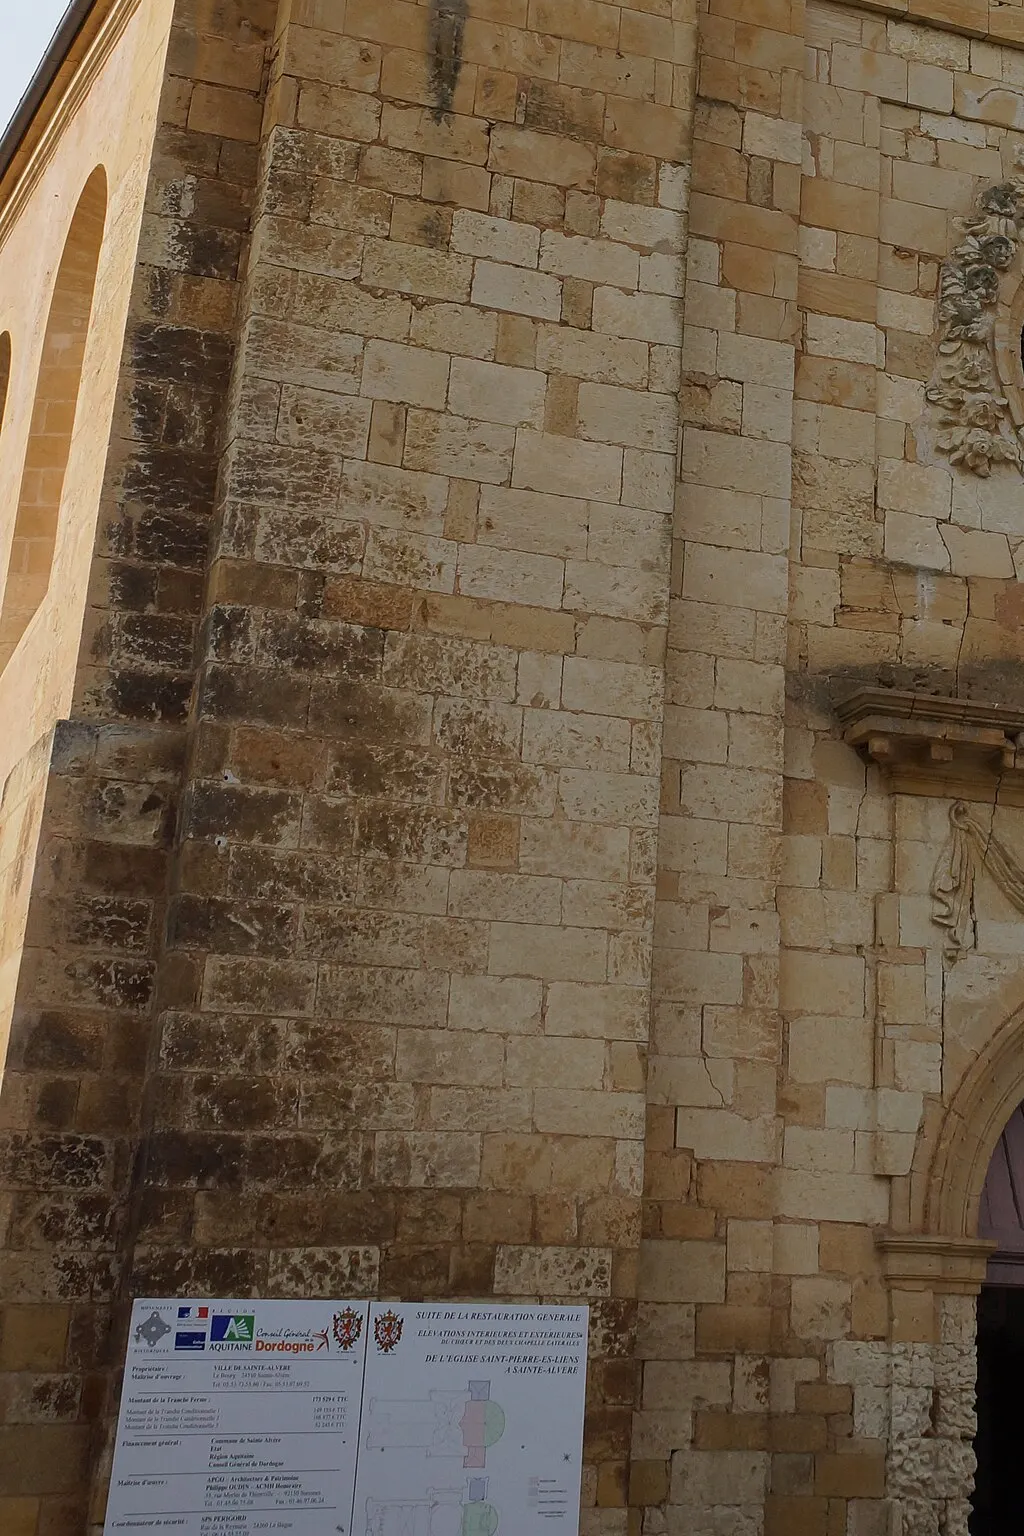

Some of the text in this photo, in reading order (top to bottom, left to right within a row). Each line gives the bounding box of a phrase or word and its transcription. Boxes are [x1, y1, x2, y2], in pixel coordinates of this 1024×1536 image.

[416, 1312, 581, 1321] SUITE DE LA RESTAURATION GENERALE
[256, 1327, 311, 1339] Conseil Général
[417, 1329, 580, 1338] ELEVATIONS INTERIEURES ET EXTERIEURES
[209, 1343, 253, 1352] AQUITAINE
[256, 1339, 315, 1353] Dordogne
[424, 1354, 580, 1363] DE L'EGLISE SAINT-PIERRE-ES-LIENS
[504, 1366, 578, 1374] A SAINTE-ALVERE
